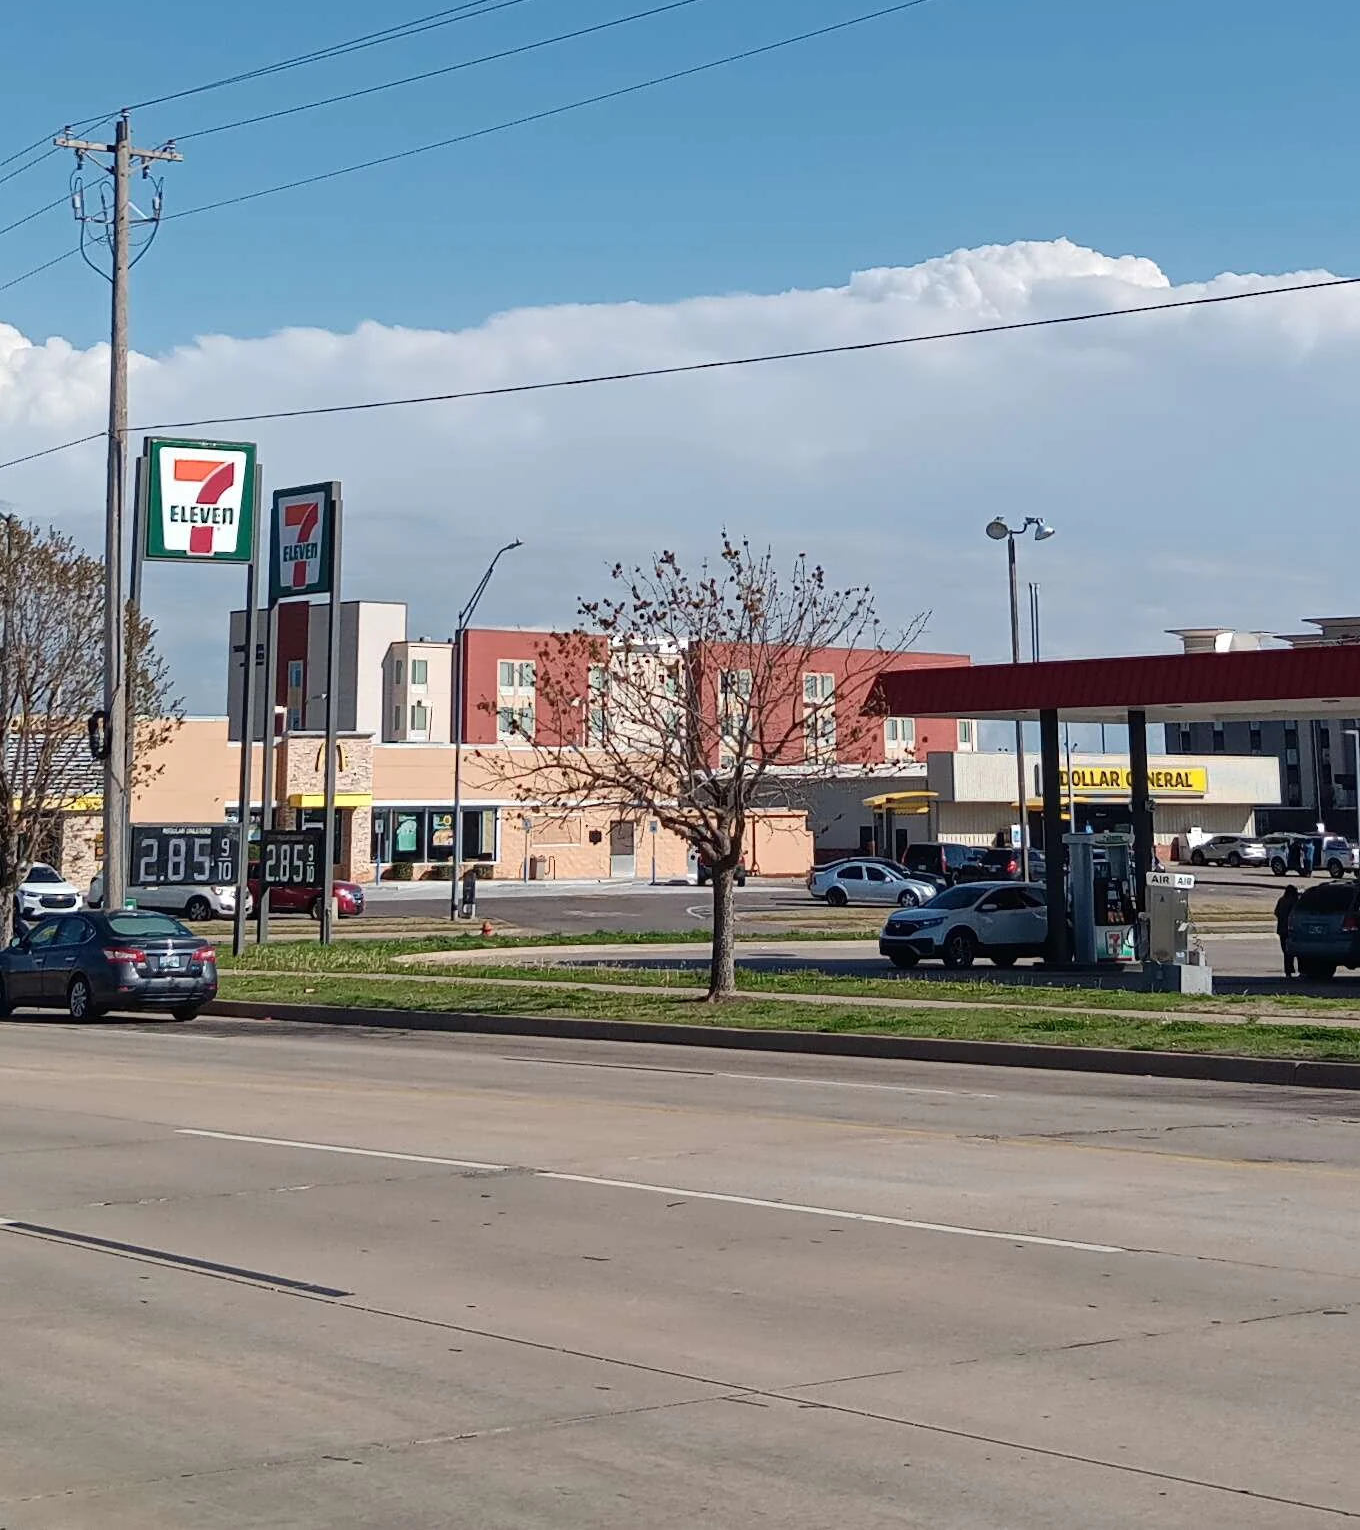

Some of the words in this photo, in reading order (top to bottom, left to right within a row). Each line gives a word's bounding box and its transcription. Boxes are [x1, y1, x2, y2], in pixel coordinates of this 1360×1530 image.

[1060, 770, 1121, 787] DOLLAR
[1126, 771, 1193, 788] GNERAL
[1151, 876, 1170, 884] AIR
[1177, 878, 1193, 886] AIR
